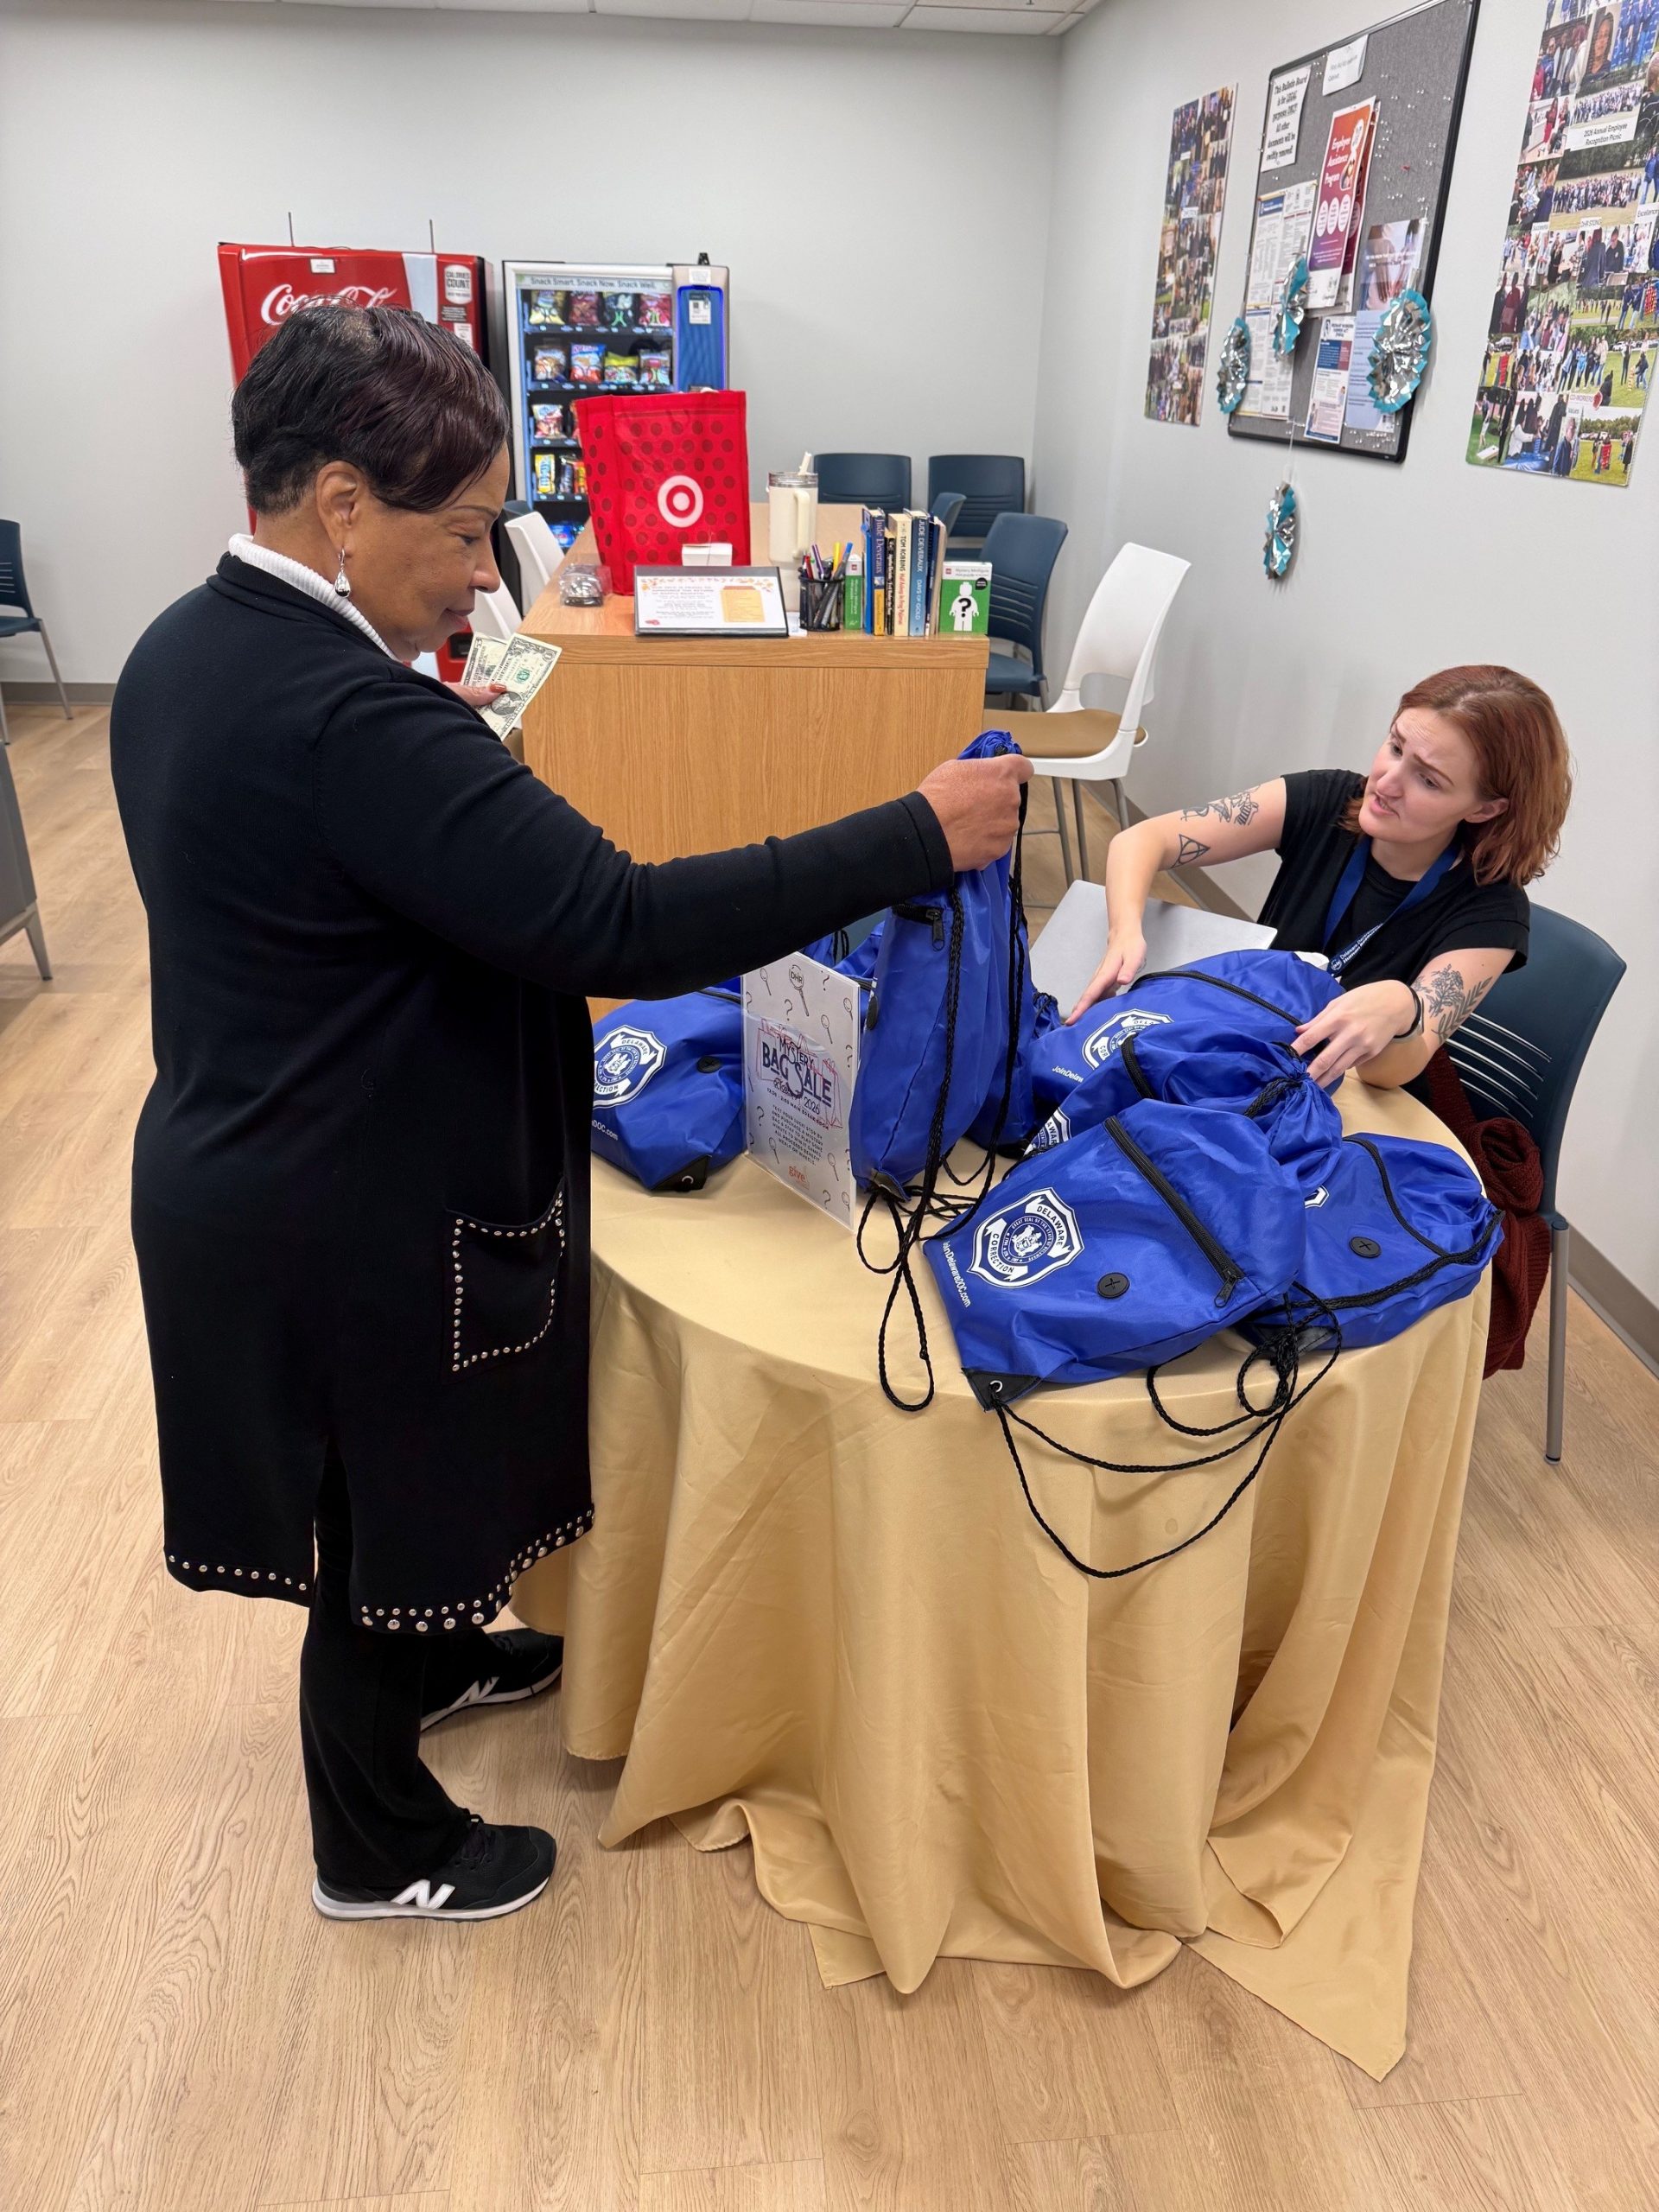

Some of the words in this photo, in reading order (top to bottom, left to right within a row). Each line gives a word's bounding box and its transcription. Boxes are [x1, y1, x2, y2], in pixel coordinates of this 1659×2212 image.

[1607, 123, 1628, 134] Employee
[1332, 135, 1351, 153] Employee
[1586, 135, 1609, 146] Recognition
[1609, 133, 1622, 143] Picnic
[1326, 153, 1349, 168] Assistance
[1325, 172, 1340, 188] Program
[447, 279, 470, 289] COUNT
[875, 518, 885, 537] Jude
[875, 538, 885, 574] Deveraux
[790, 971, 803, 983] DHR
[621, 1039, 648, 1056] DELAWARE
[779, 1038, 814, 1069] MYSTERY
[762, 1040, 789, 1083] BAG
[787, 1061, 832, 1106] SALE
[1052, 1065, 1084, 1083] JoinDelaw
[804, 1096, 820, 1115] 2026
[781, 1116, 801, 1132] PURCHASE
[805, 1132, 823, 1147] MYSTERY
[783, 1135, 803, 1151] PROCEEDS
[804, 1148, 820, 1161] BENEFIT
[788, 1166, 805, 1182] give
[1037, 1205, 1065, 1246] DELAWARE
[989, 1233, 1014, 1273] CORRECTION
